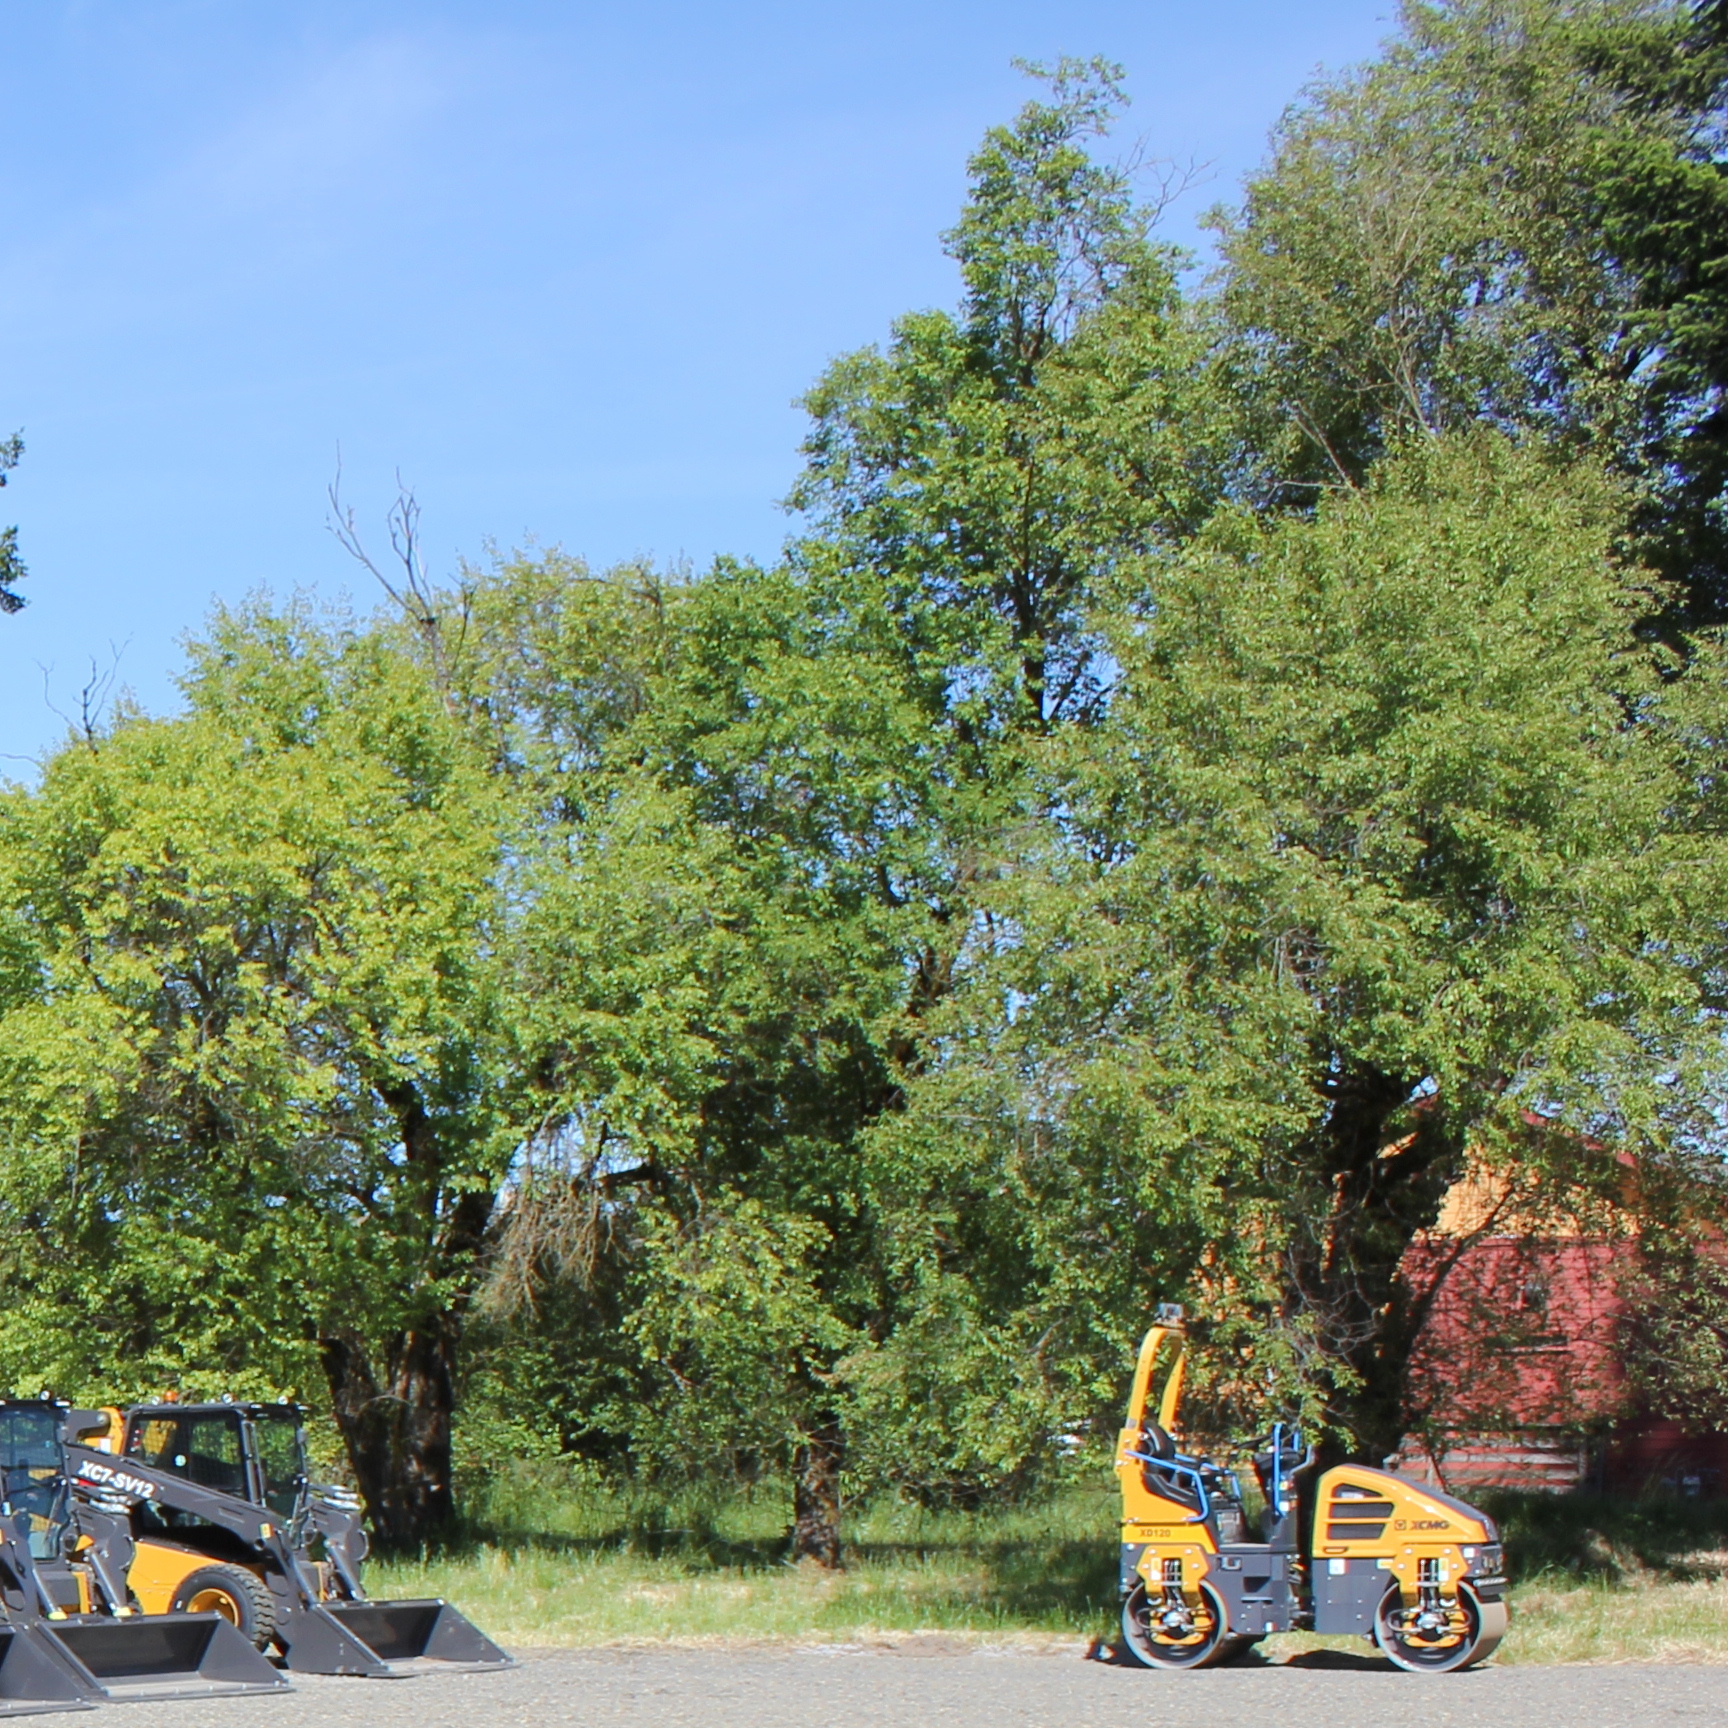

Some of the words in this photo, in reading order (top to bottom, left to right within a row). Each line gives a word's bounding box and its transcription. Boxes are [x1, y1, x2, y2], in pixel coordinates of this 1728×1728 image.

[77, 1460, 155, 1498] XC7-SV12
[1409, 1520, 1450, 1531] XCMG
[1139, 1528, 1171, 1538] XD120
